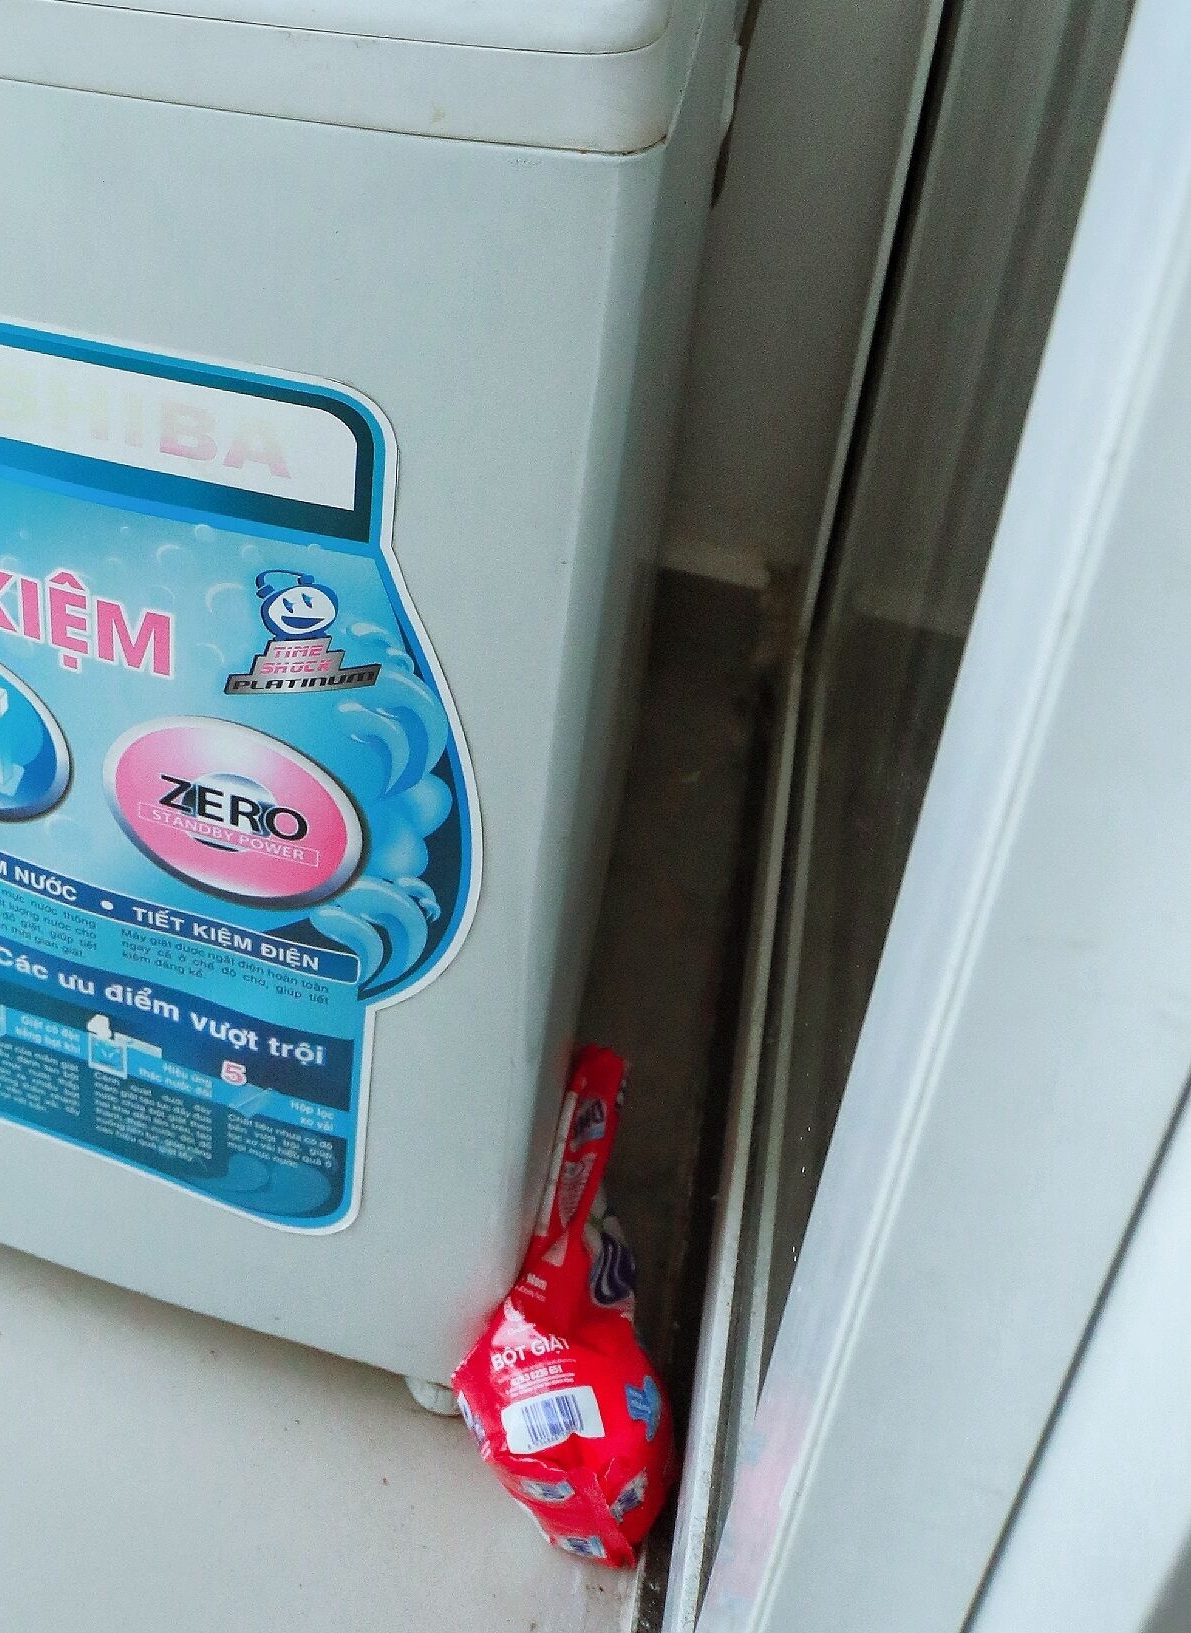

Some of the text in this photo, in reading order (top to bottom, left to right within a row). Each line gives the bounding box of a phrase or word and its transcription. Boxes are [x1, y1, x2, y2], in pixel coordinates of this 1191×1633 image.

[273, 645, 325, 658] TIME
[231, 669, 377, 690] PLATINUM
[158, 773, 309, 842] ZERO
[152, 808, 306, 861] STANDBY POWER
[14, 866, 78, 901] NƯỚC
[132, 904, 319, 972] TIẾT KIỆM ĐIỆN
[58, 963, 96, 997] ưu
[104, 981, 181, 1023] điểm
[189, 1010, 259, 1053] vượt
[267, 1034, 326, 1065] trội
[221, 1059, 248, 1086] 5
